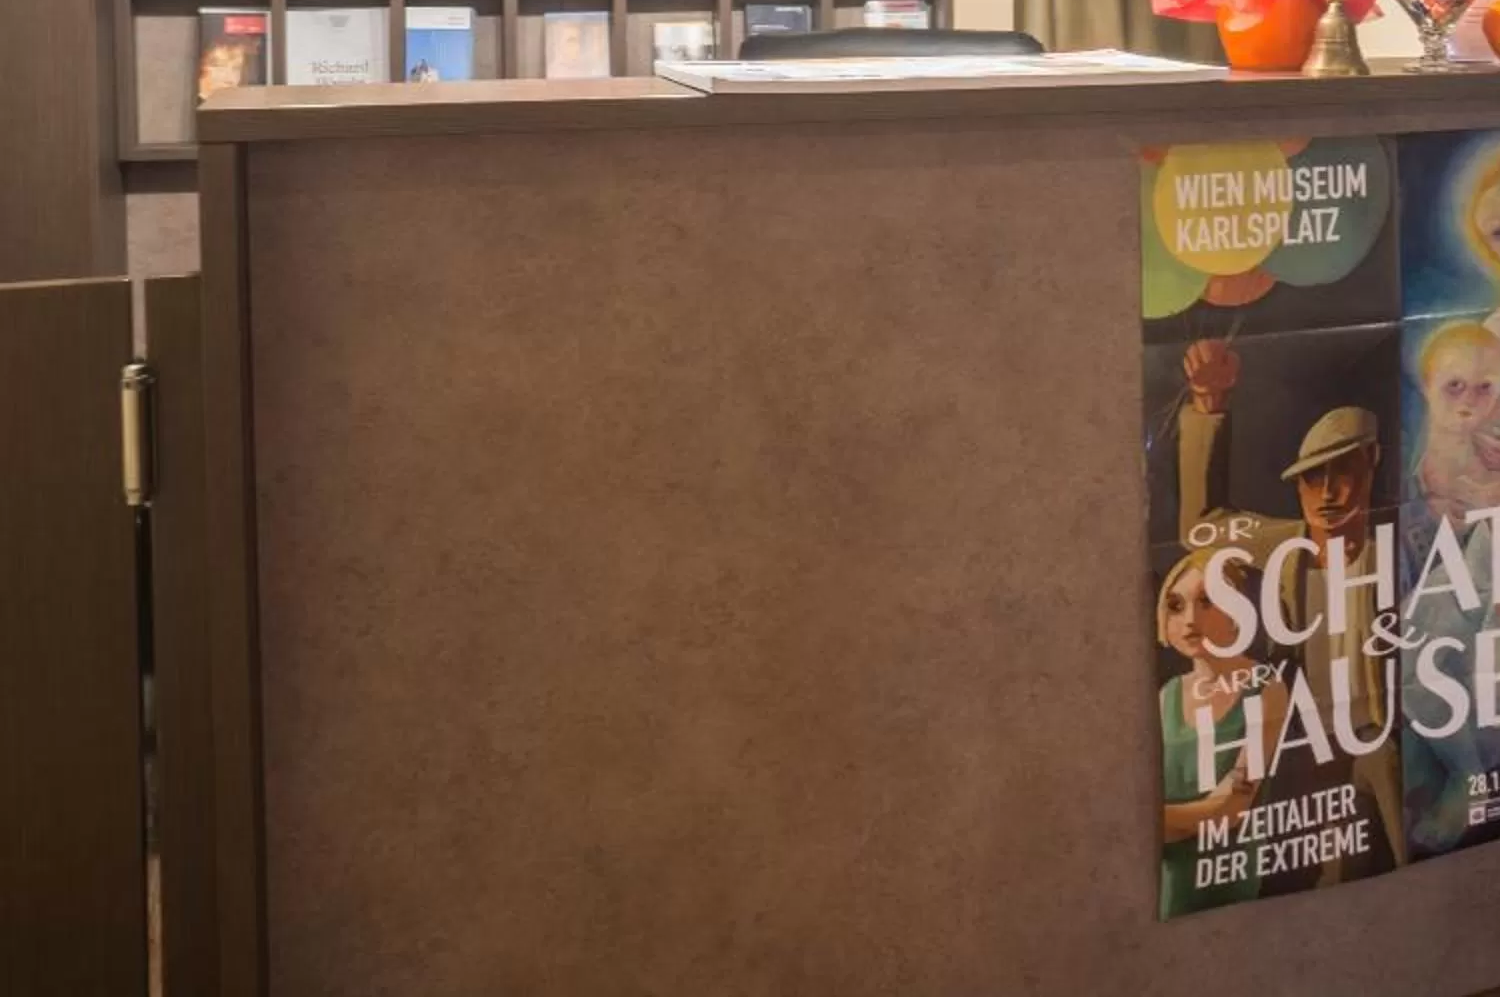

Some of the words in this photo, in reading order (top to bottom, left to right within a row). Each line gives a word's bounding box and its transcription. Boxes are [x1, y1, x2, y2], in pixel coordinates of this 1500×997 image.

[1174, 172, 1246, 210] WIEN
[1252, 163, 1368, 204] MUSEUM
[1176, 207, 1341, 253] KARLSPLATZ
[1362, 611, 1428, 657] &
[1191, 659, 1289, 701] CARRY
[1197, 818, 1229, 853] IM
[1236, 783, 1358, 846] ZEITALTER
[1195, 849, 1248, 889] DER
[1256, 819, 1371, 878] EXTREME
